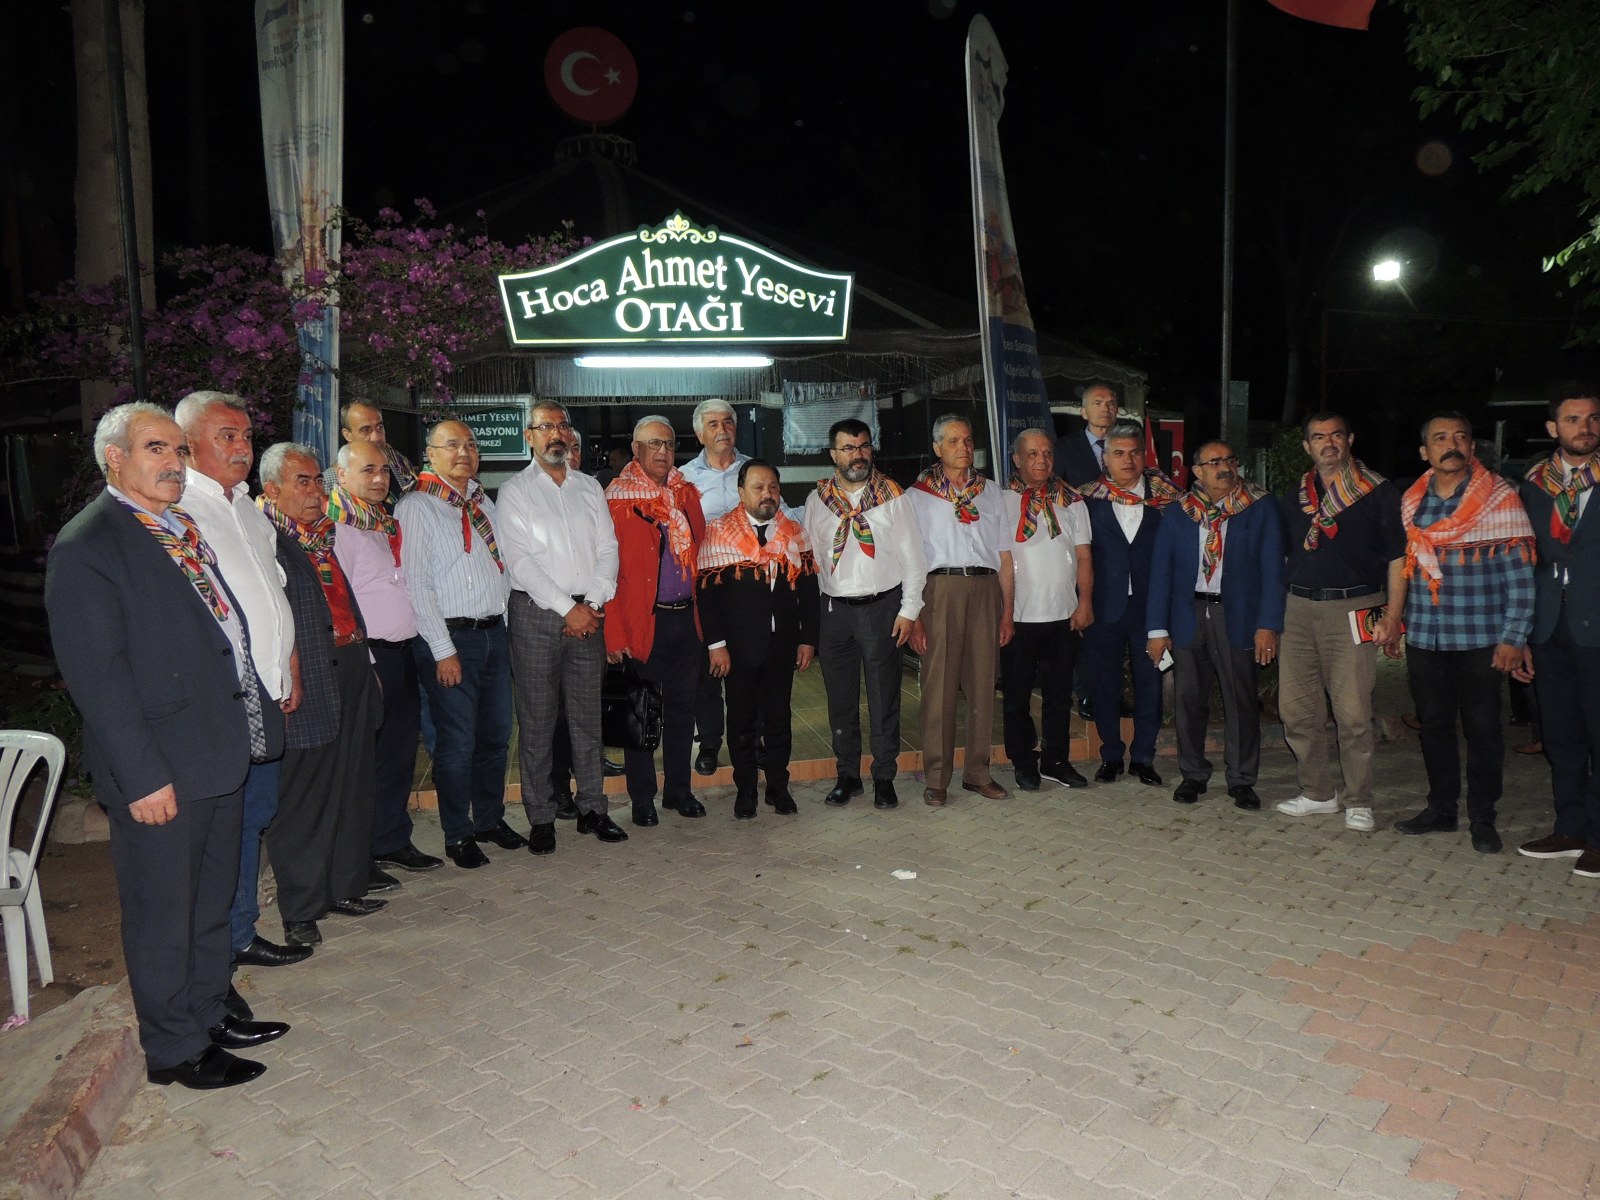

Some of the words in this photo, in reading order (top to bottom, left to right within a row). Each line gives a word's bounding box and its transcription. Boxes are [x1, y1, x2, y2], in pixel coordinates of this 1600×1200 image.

[516, 277, 609, 319] Hoca
[616, 248, 728, 295] Ahmet
[735, 257, 837, 317] Yesevi
[615, 296, 745, 332] OTAĞI
[489, 412, 520, 421] YESEVİ
[473, 427, 519, 436] RASYONU
